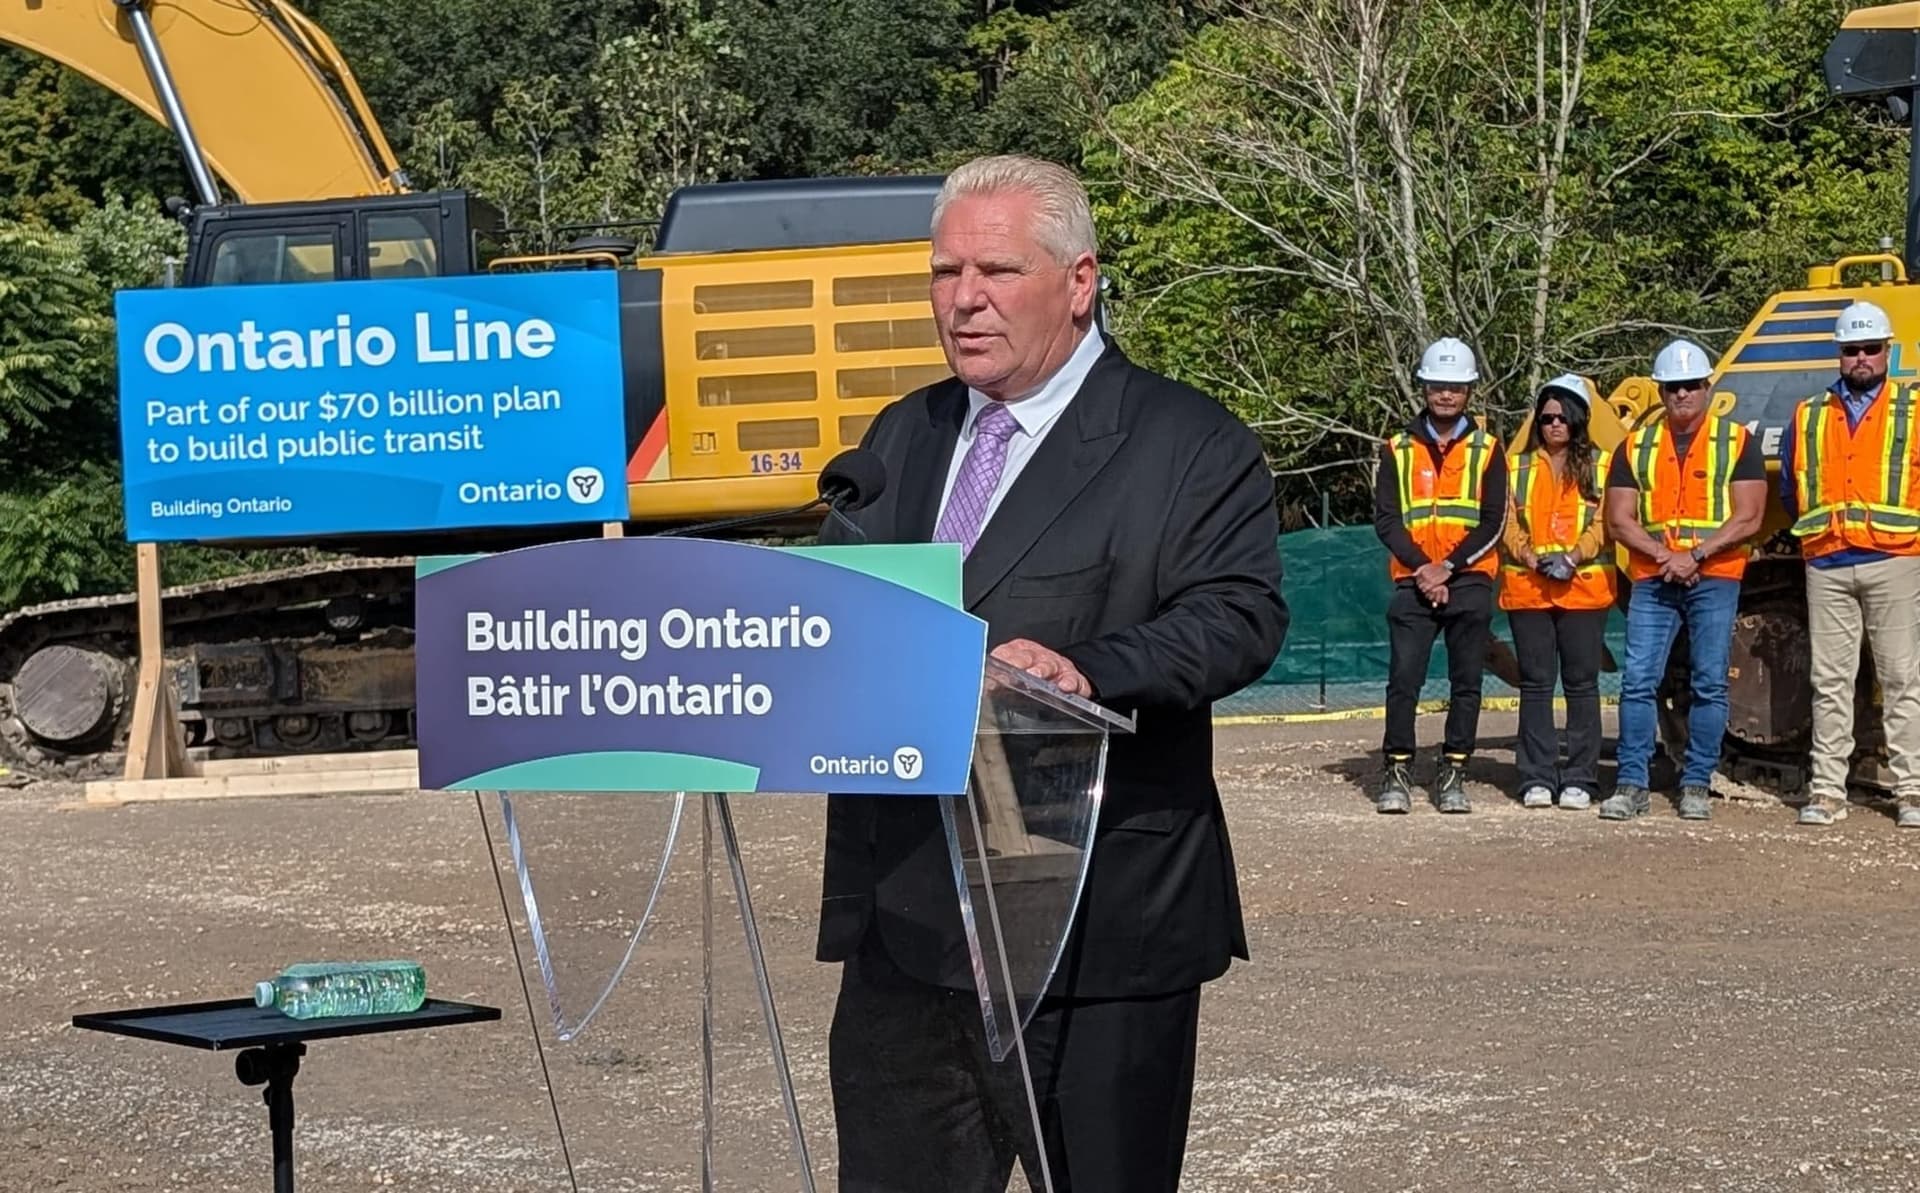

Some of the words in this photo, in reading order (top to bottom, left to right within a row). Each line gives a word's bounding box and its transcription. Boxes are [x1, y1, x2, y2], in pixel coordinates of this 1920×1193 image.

[1851, 320, 1873, 329] EBC
[144, 314, 396, 374] Ontario
[415, 309, 556, 363] Line
[147, 399, 210, 426] Part
[218, 396, 251, 424] of
[259, 401, 310, 422] our
[318, 391, 379, 422] $70
[388, 389, 484, 417] billion
[493, 385, 561, 419] plan
[147, 438, 180, 463] to
[188, 433, 268, 461] build
[278, 429, 375, 465] public
[383, 424, 484, 454] transit
[750, 452, 802, 474] 16-34
[151, 499, 223, 518] Building
[226, 496, 292, 514] Ontario
[459, 479, 562, 504] Ontario
[467, 608, 647, 661] Building
[659, 605, 831, 649] Ontario
[467, 674, 570, 716] Bâtir
[580, 673, 773, 716] l’Ontario
[810, 755, 889, 775] Ontario
